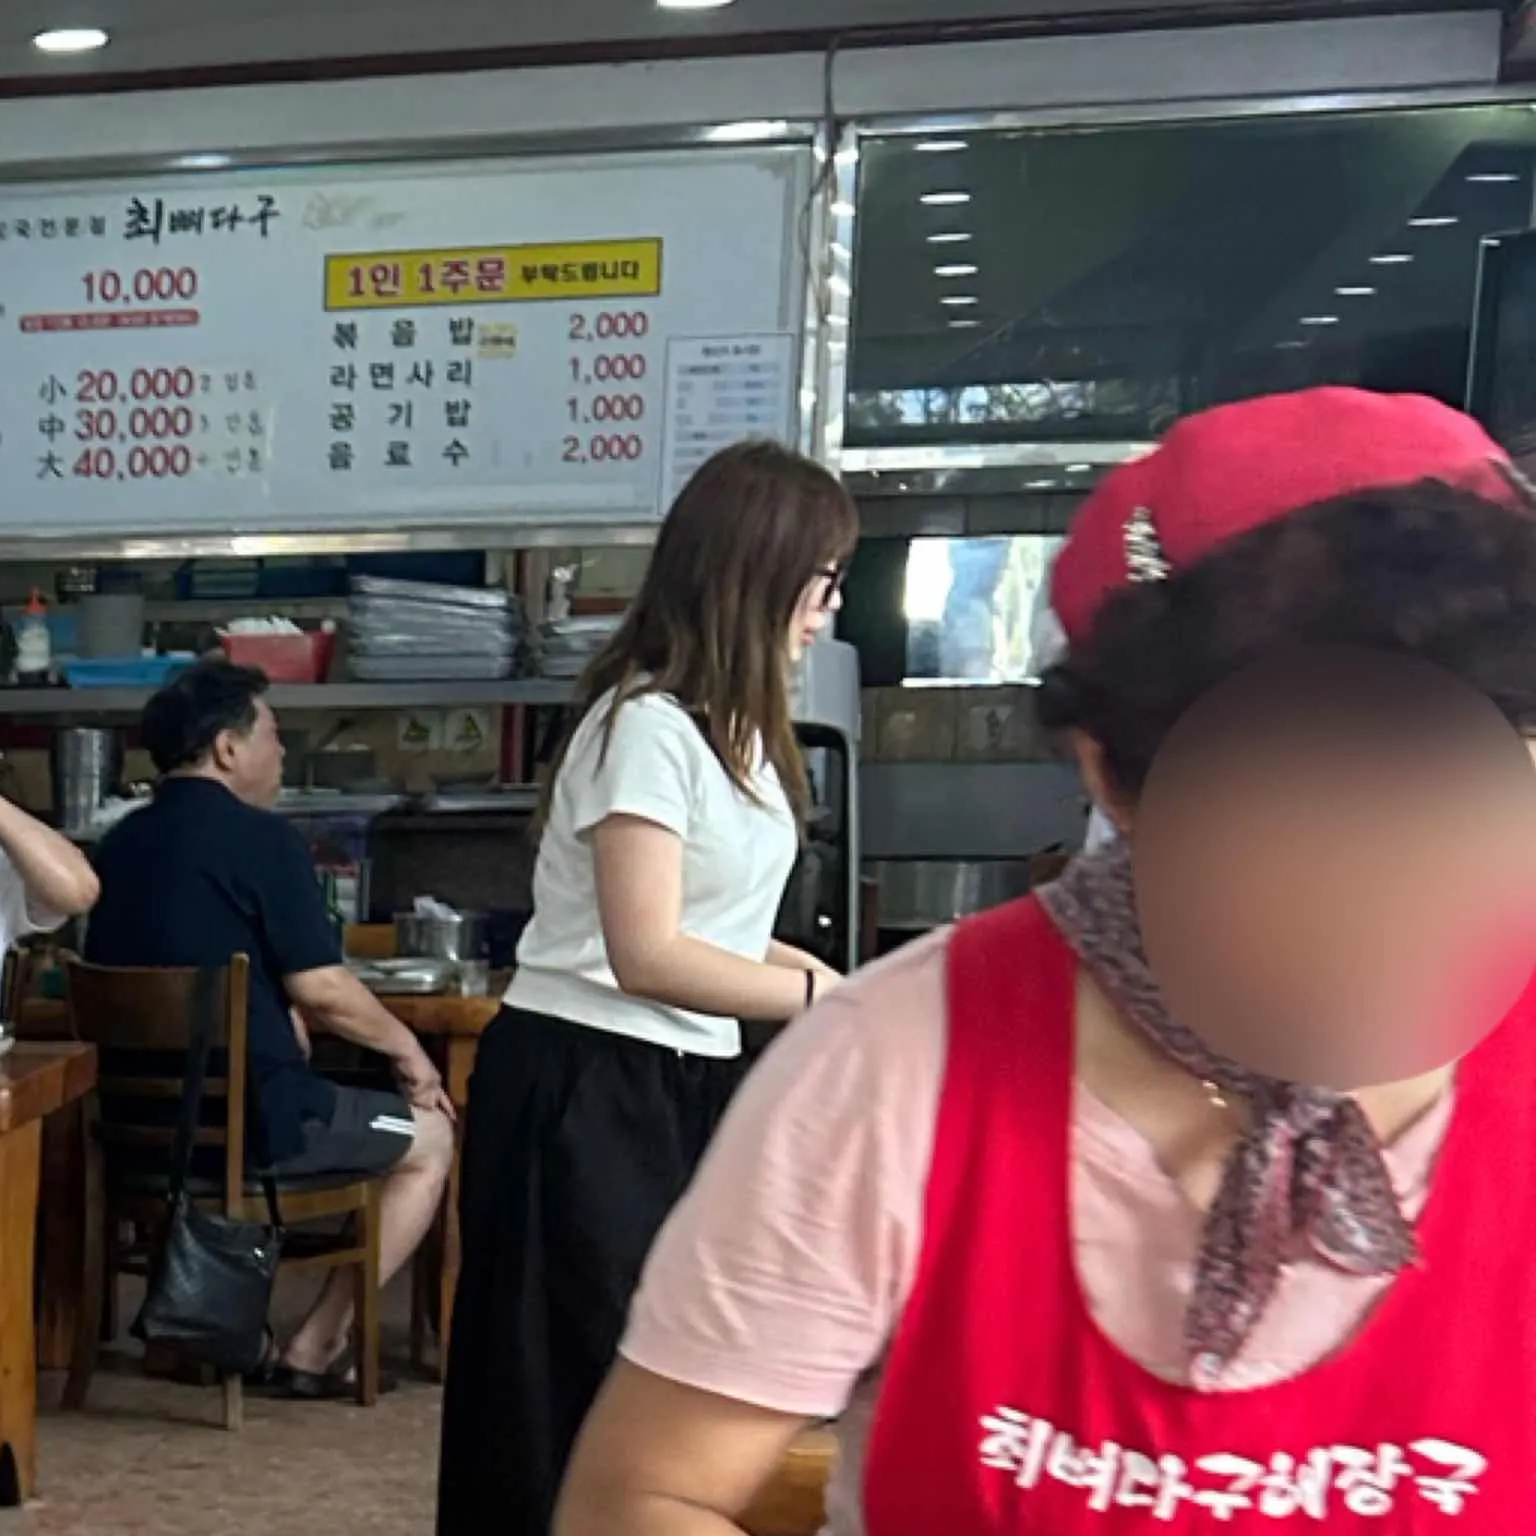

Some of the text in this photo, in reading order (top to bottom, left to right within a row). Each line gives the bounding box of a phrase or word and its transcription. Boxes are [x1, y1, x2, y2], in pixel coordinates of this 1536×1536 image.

[82, 267, 198, 304] 10,000
[348, 264, 401, 297] 1인
[418, 256, 506, 294] 1주문
[568, 311, 650, 342] 2,000
[38, 373, 68, 405] 小
[75, 365, 194, 404] 20,000
[329, 353, 647, 391] 라면사리 1,000
[38, 412, 66, 443] 中
[74, 405, 193, 444] 30,000
[331, 393, 645, 432] 공기밥 1,000
[35, 448, 65, 480] 大
[72, 444, 192, 482] 40,000
[328, 433, 644, 471] 음료수 2,000
